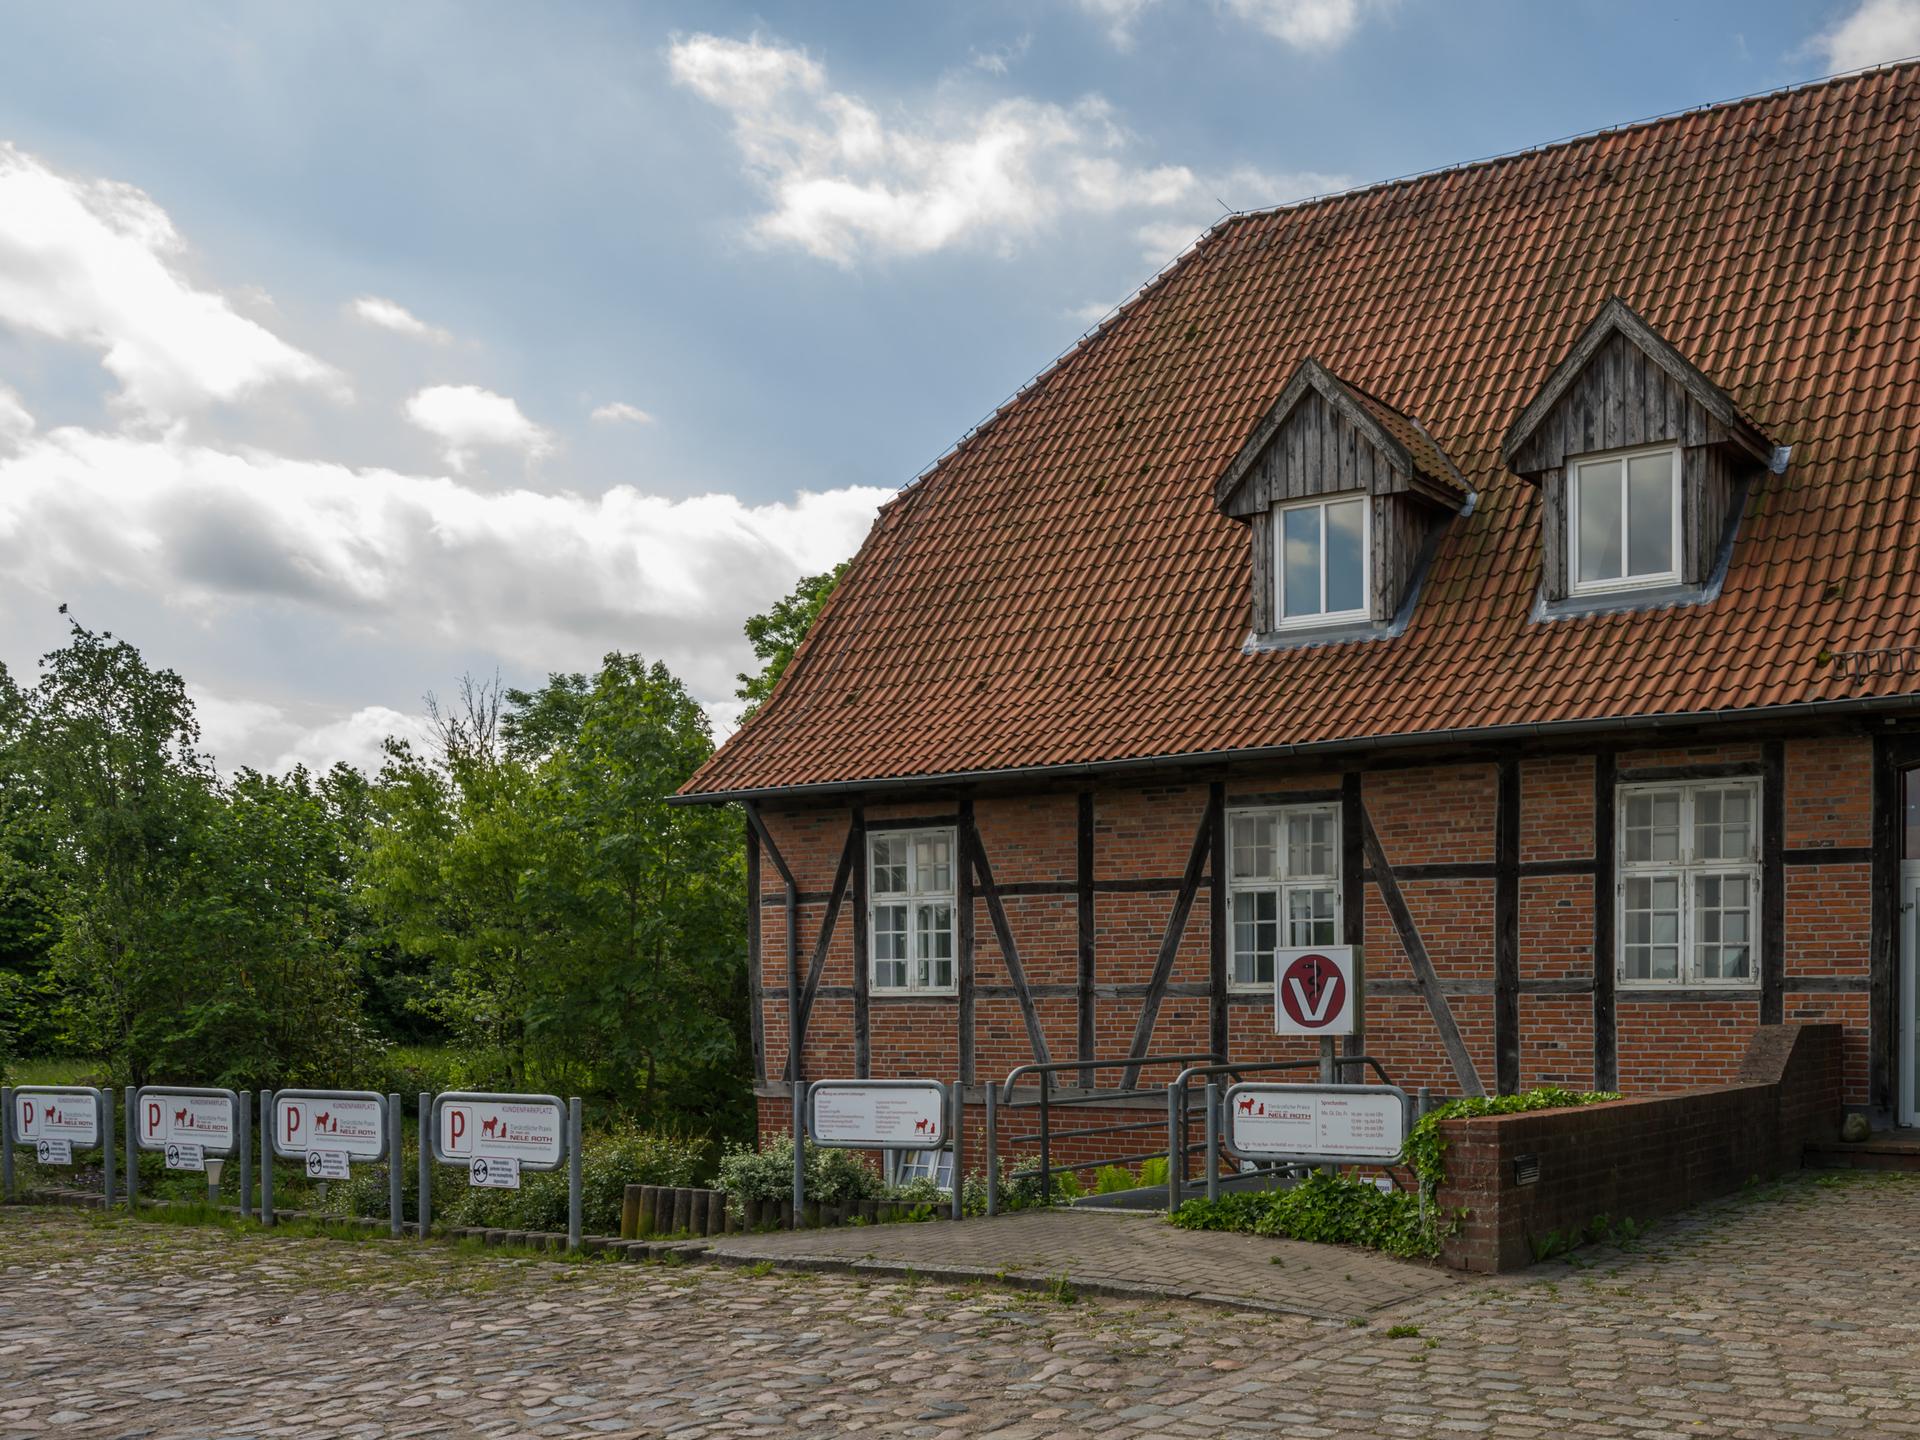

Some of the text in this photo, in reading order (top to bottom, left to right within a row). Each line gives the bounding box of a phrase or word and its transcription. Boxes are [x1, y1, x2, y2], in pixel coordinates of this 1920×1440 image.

[1288, 976, 1338, 1021] V
[23, 1101, 34, 1133] P
[149, 1103, 161, 1136] P
[287, 1106, 300, 1142] P
[502, 1106, 552, 1115] KUNDENPARKPLATZ
[451, 1110, 465, 1149] P
[531, 1135, 553, 1143] ROTH
